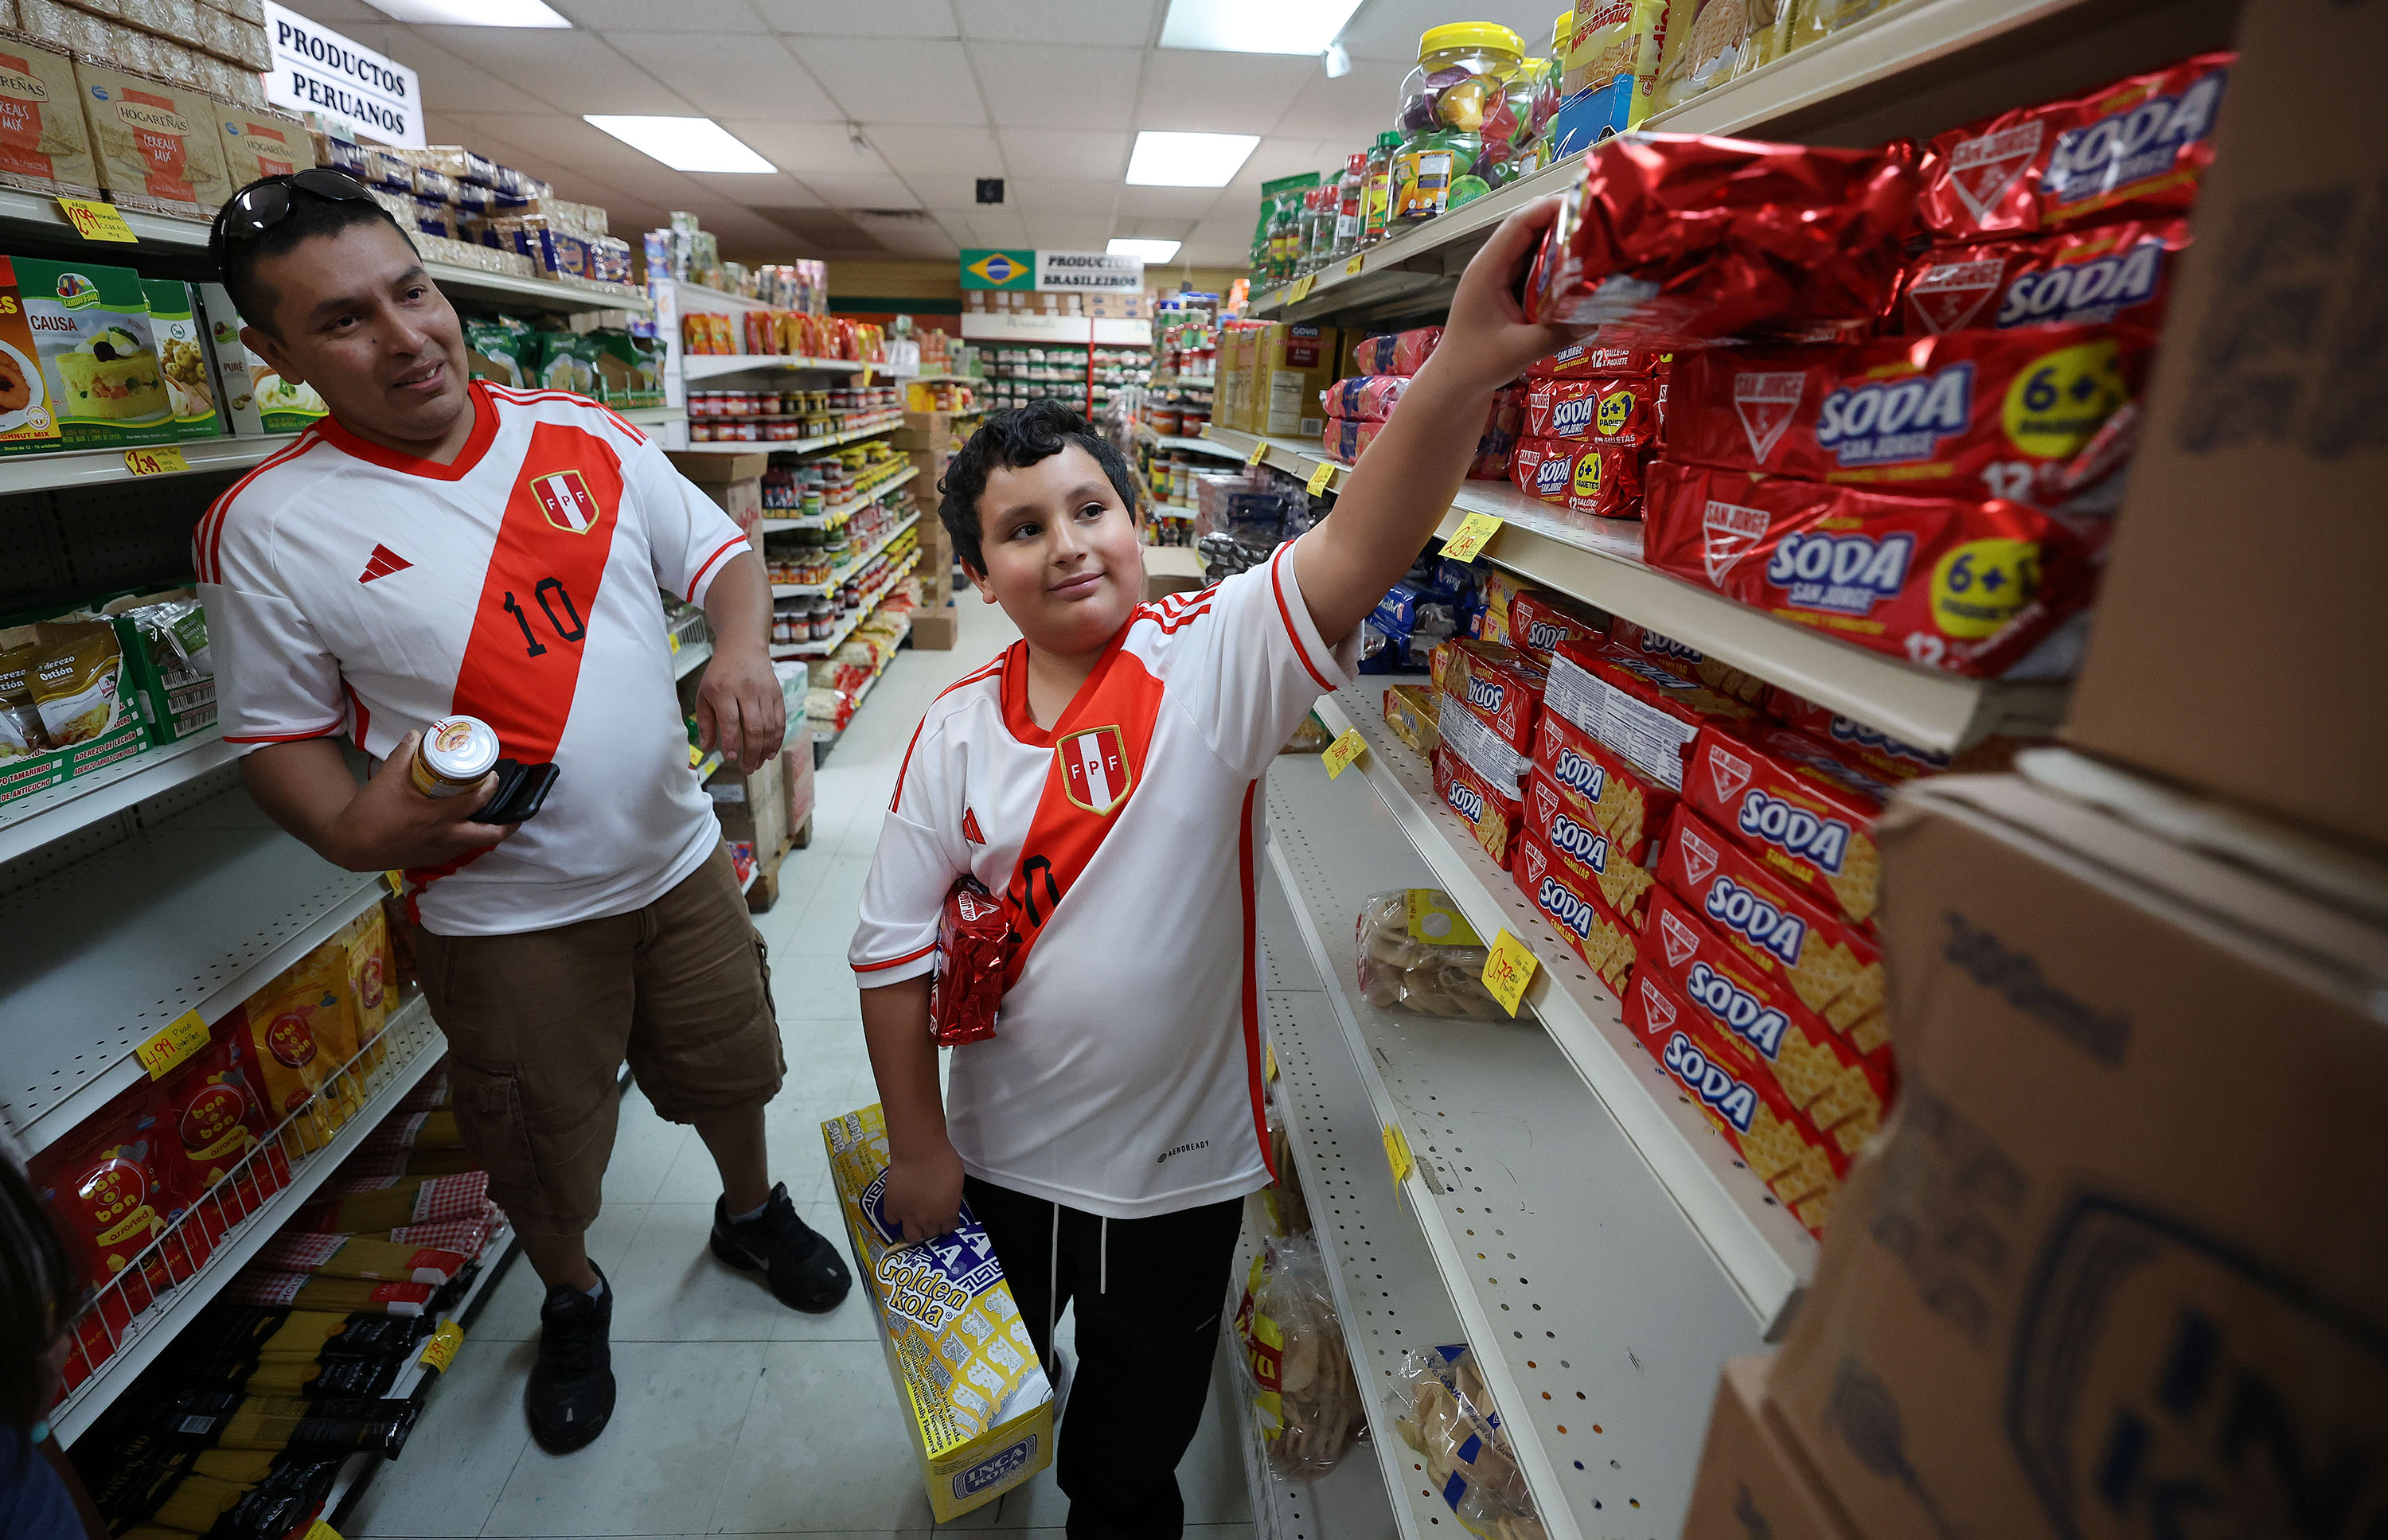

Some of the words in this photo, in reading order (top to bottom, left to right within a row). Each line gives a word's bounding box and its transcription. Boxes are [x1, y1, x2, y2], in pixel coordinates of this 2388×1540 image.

[276, 19, 406, 97] PRODUCTOS
[0, 75, 45, 96] REÑAS
[292, 71, 405, 135] PERUANOS
[2, 116, 24, 132] MIX
[120, 107, 188, 131] HOGAREÑAS
[143, 134, 177, 153] CEREALS
[154, 150, 172, 163] MIX
[68, 207, 102, 236] 2.99
[1043, 274, 1137, 287] BRASILEIROS
[1996, 241, 2160, 325] SODA
[84, 292, 98, 304] Food
[30, 314, 78, 332] CAUSA
[1592, 350, 1602, 368] 12
[1606, 357, 1628, 367] PAQUETE
[1554, 394, 1594, 429] SODA
[1601, 395, 1633, 419] 6+1
[1817, 363, 1972, 446] SODA
[1559, 425, 1571, 436] SAN
[1571, 422, 1584, 435] JORGE
[1538, 455, 1571, 486] SODA
[1578, 457, 1600, 481] 6+1
[1541, 482, 1552, 493] SAN
[1576, 481, 1599, 490] PAQUETES
[1569, 496, 1578, 511] 12
[1706, 501, 1730, 526] SAN
[1730, 508, 1770, 539] JORGE
[1768, 531, 1913, 597] SODA
[504, 577, 585, 658] 10
[40, 666, 74, 681] Ostión
[113, 715, 131, 730] ADOBO
[74, 746, 103, 762] ADEREZO
[104, 739, 115, 752] DE
[113, 731, 137, 747] LECHÓN
[74, 761, 96, 776] ADEREZO
[123, 745, 138, 758] POLLO
[10, 763, 51, 783] TAMARINDO
[1555, 747, 1606, 804] SODA
[0, 792, 11, 802] DE
[12, 778, 50, 798] ANTICUCHO
[1448, 780, 1483, 825] SODA
[1537, 781, 1547, 796] SAN
[1547, 788, 1559, 808] JORGE
[1551, 813, 1609, 875] SODA
[1739, 788, 1851, 875] SODA
[1526, 841, 1537, 857] SAN
[1535, 849, 1547, 868] JORGE
[1563, 856, 1590, 880] FAMILIAR
[1766, 847, 1816, 884] FAMILIAR
[961, 906, 976, 921] SAN
[1538, 876, 1594, 942] SODA
[1705, 875, 1806, 969] SODA
[1551, 918, 1576, 945] FAMILIAR
[1488, 946, 1513, 990] 0.79
[1642, 977, 1657, 996] SAN
[1686, 961, 1791, 1063] SODA
[146, 1037, 176, 1072] 4.99
[289, 1039, 312, 1059] bon
[1664, 1031, 1758, 1136] SODA
[191, 1095, 227, 1121] bon
[208, 1113, 220, 1123] o
[199, 1114, 235, 1140] bon
[210, 1130, 245, 1157] assorted
[1168, 1140, 1210, 1158] AEROREADY
[95, 1192, 137, 1223] bon
[103, 1191, 117, 1203] o
[109, 1210, 150, 1242] assorted
[878, 1253, 970, 1311] Golden
[890, 1285, 944, 1328] kola
[896, 1337, 911, 1371] Artificially
[911, 1386, 926, 1420] Naturally
[922, 1420, 938, 1455] Flavored
[909, 1349, 919, 1374] golden
[917, 1374, 932, 1414] carbonated
[929, 1413, 945, 1451] beverage
[913, 1335, 926, 1364] Sabores
[923, 1364, 938, 1402] Artificiales
[938, 1407, 953, 1446] Naturales
[1431, 1368, 1442, 1378] es
[1439, 1374, 1461, 1402] GOYA
[1476, 1422, 1488, 1436] que
[942, 1394, 951, 1413] kola
[947, 1413, 960, 1443] dorada
[967, 1447, 1025, 1483] INCA
[974, 1459, 1021, 1487] KOLA
